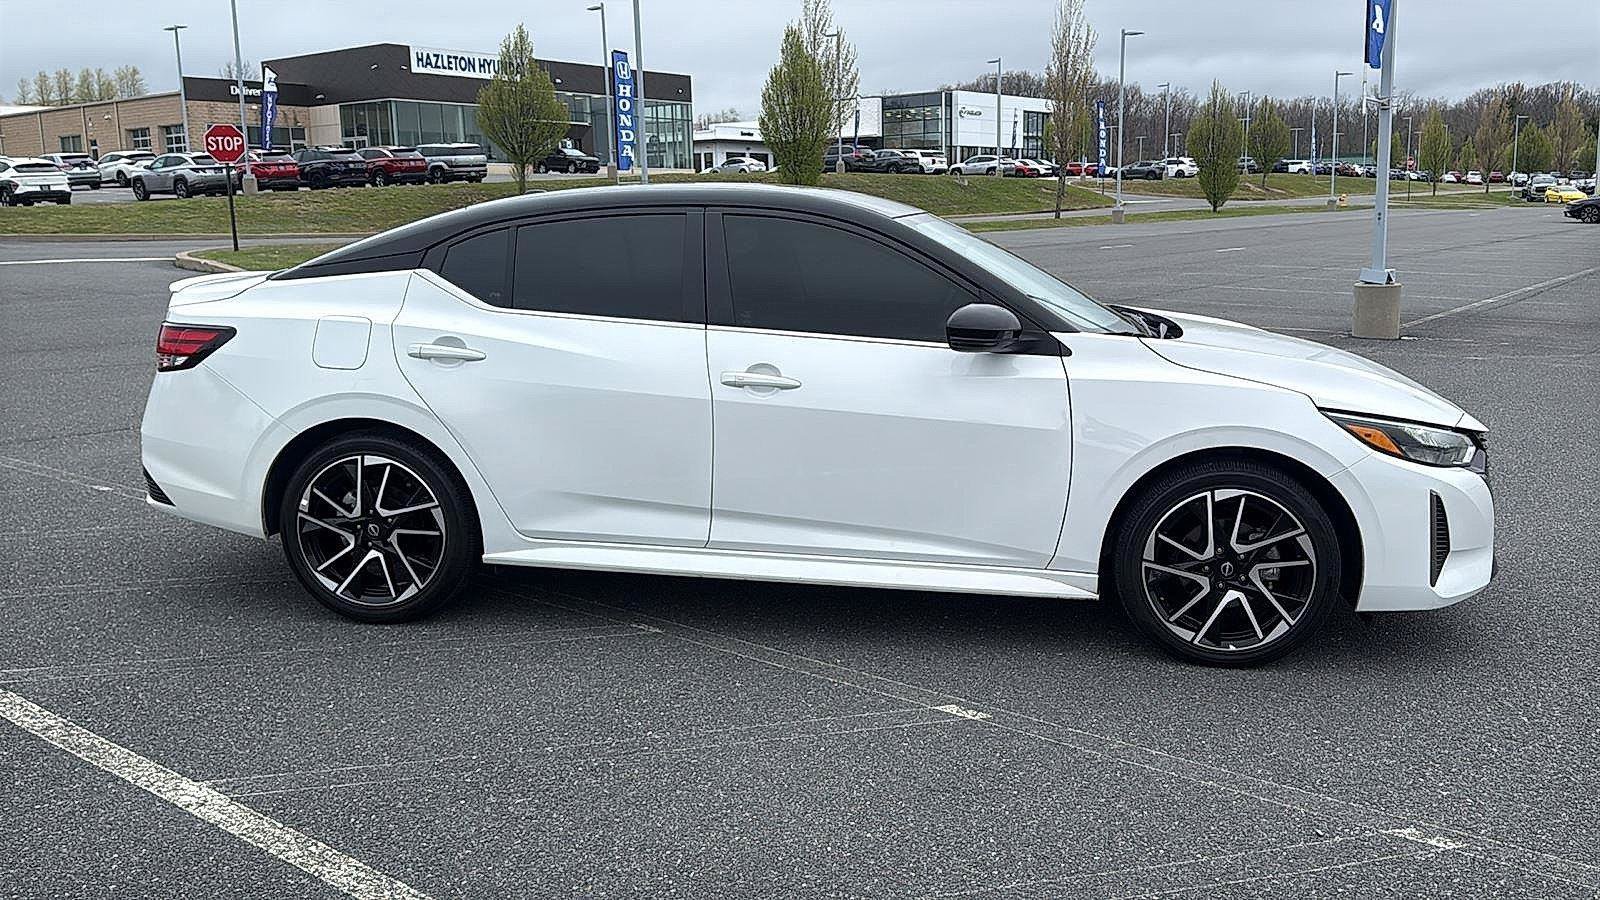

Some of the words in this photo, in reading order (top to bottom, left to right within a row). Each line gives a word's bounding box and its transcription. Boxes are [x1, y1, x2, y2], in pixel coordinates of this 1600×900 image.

[416, 51, 476, 73] HAZLETON
[618, 83, 635, 160] HONDA
[207, 136, 243, 151] STOP
